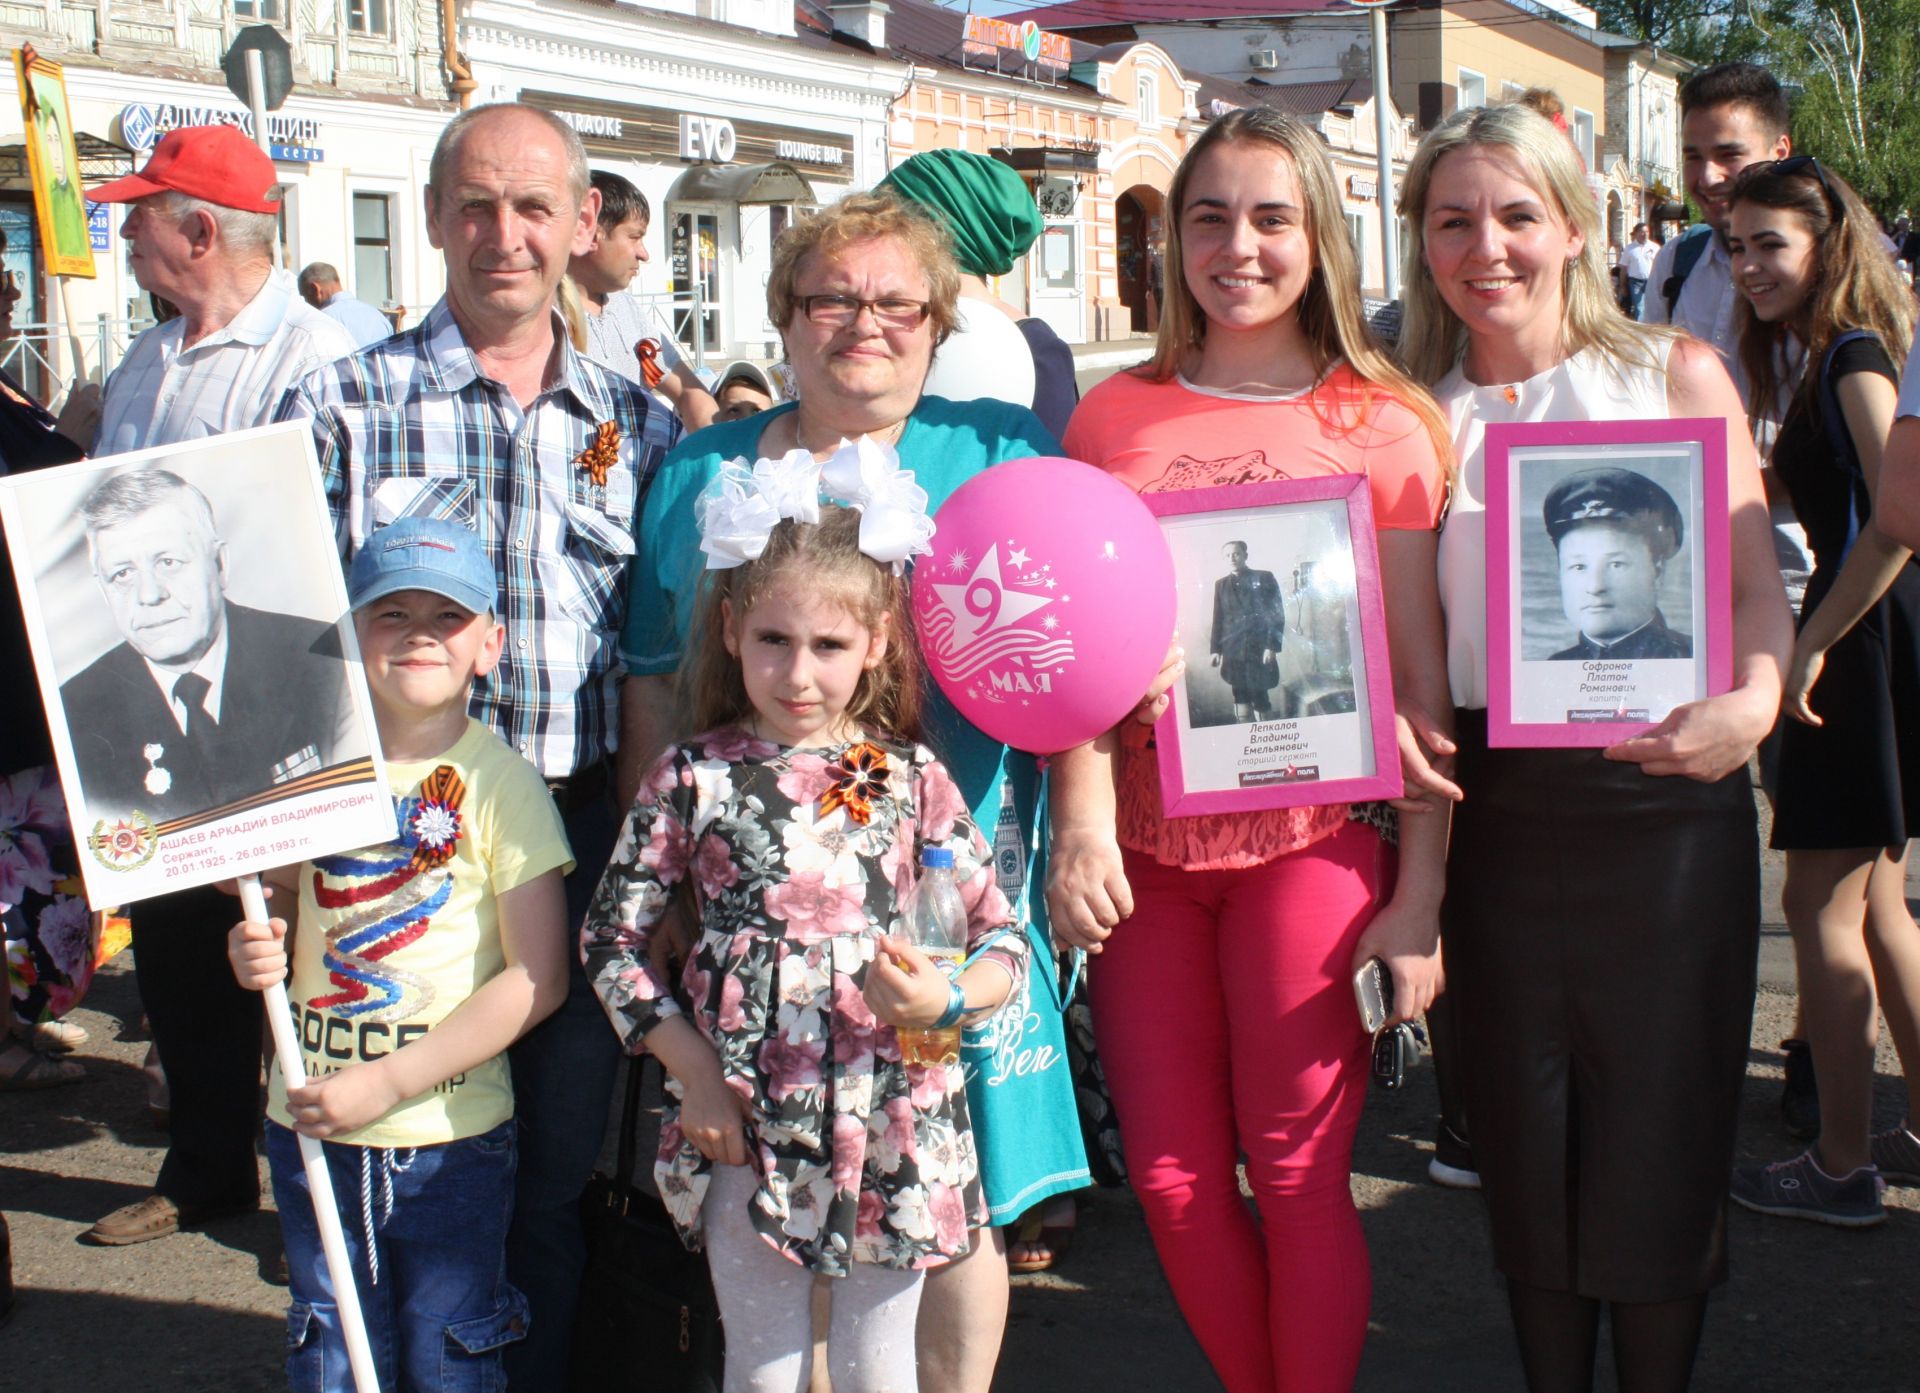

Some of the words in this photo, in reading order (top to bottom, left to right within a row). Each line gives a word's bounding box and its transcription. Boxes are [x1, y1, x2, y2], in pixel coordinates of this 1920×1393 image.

[967, 15, 1024, 51] АПТЕКА
[1041, 31, 1072, 61] ВИТА
[680, 114, 736, 162] EVO
[283, 147, 320, 160] сеть
[778, 140, 821, 161] LOUNGE
[823, 146, 843, 164] BAR
[965, 578, 1001, 637] 9
[1582, 661, 1633, 673] Софронов
[989, 670, 1053, 695] МАЯ
[1587, 672, 1628, 682] Платон
[1579, 683, 1636, 693] Романович
[1249, 721, 1298, 734] Лепкалов
[1250, 732, 1300, 744] Владимир
[1243, 742, 1309, 756] Емельянович
[1237, 753, 1277, 766] старший
[1278, 751, 1318, 764] сержант
[1297, 768, 1316, 776] полк
[160, 832, 207, 850] АШАЕВ
[209, 815, 268, 840] АРКАДИЙ
[271, 793, 375, 825] ВЛАДИМИРОВИЧ
[162, 846, 217, 865] Сержант,
[165, 855, 226, 878] 20.01.1925
[236, 839, 296, 861] 26.08.1993
